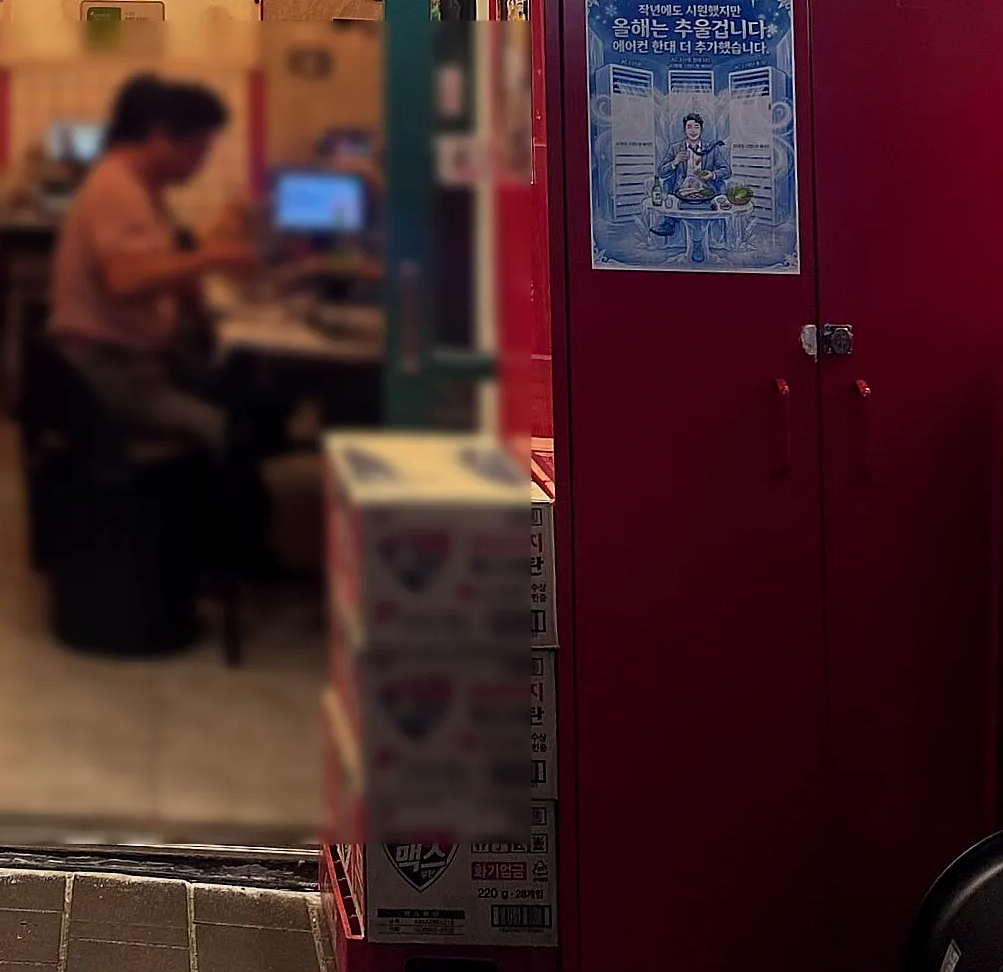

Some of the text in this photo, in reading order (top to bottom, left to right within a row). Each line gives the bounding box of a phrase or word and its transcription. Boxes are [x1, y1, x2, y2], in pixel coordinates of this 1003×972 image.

[638, 4, 742, 18] 작년에도 시원했지만
[612, 17, 670, 38] 올해는
[612, 40, 649, 54] 에어컨
[652, 40, 677, 54] 한대
[680, 40, 692, 54] 더
[395, 843, 446, 873] 맥스
[473, 863, 525, 879] 화기엄금
[477, 887, 498, 899] 220
